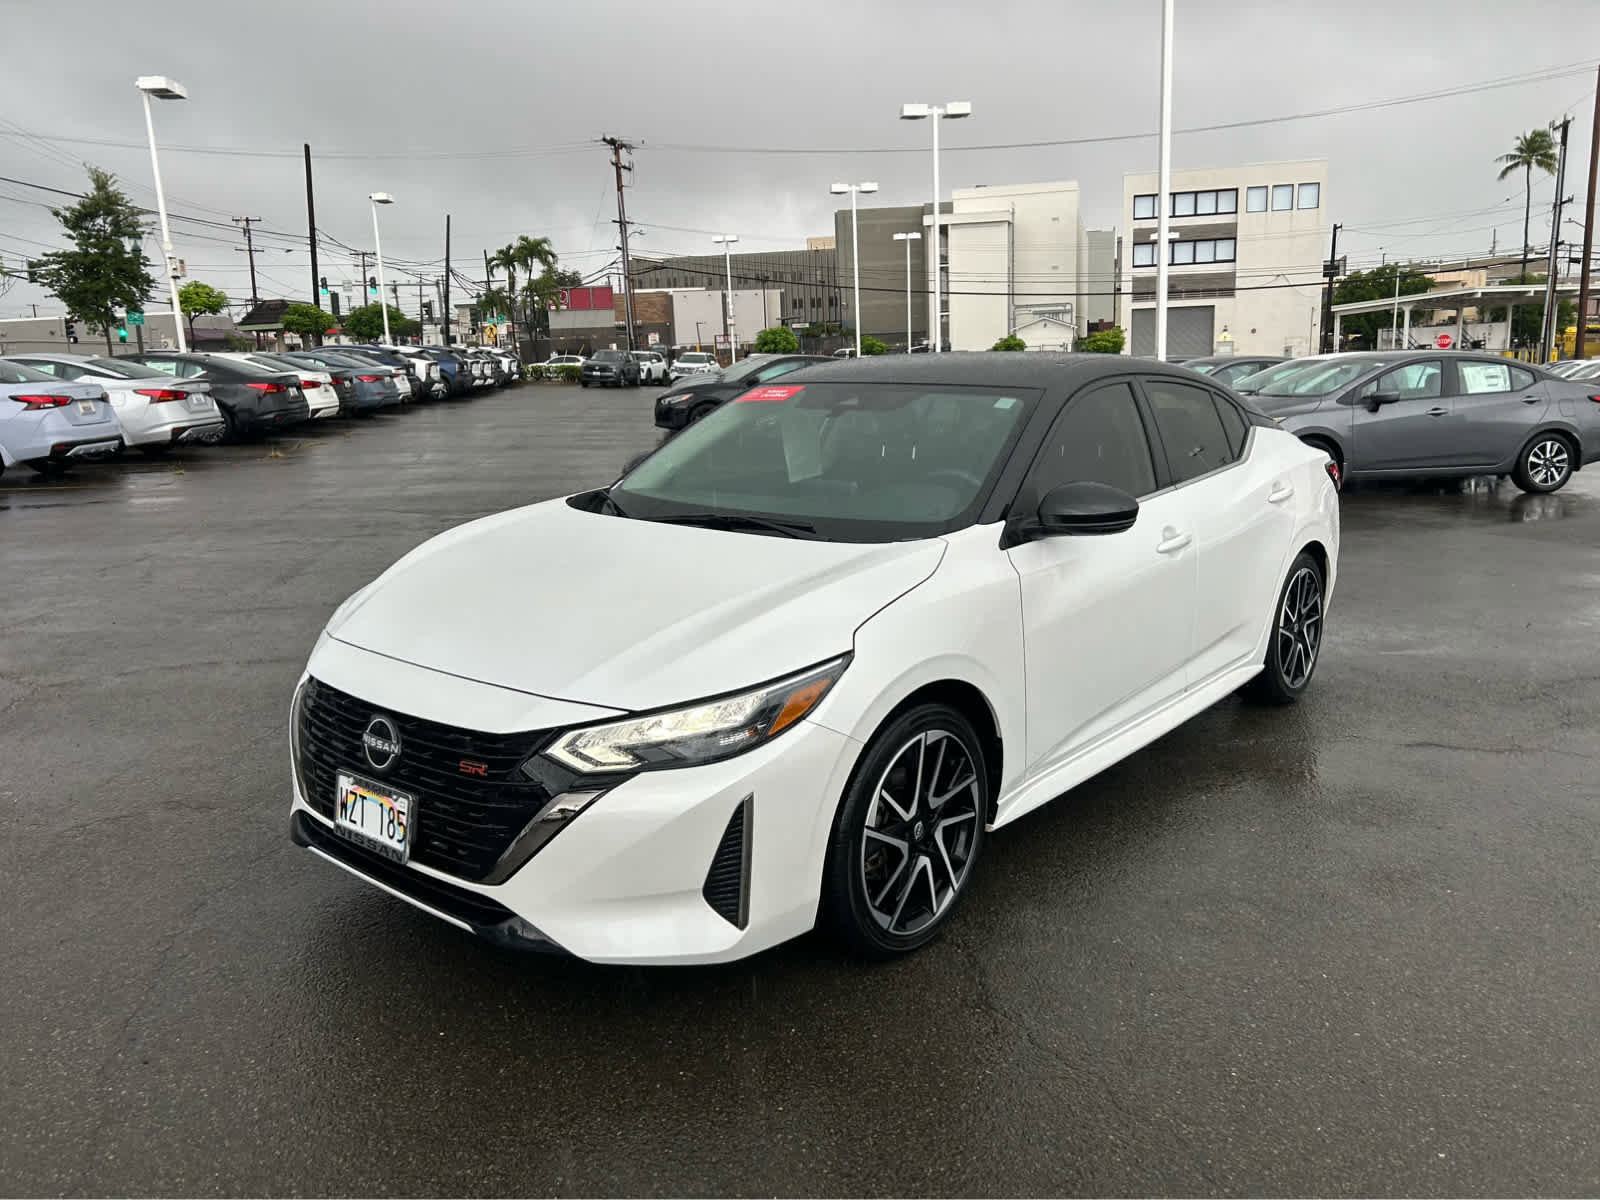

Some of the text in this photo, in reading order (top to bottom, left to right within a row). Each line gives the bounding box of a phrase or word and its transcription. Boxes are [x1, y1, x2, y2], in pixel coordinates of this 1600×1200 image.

[362, 732, 399, 754] NISSAN
[459, 760, 488, 776] SR
[340, 786, 367, 828] WZT
[380, 803, 406, 843] 185
[335, 824, 403, 863] NISSAN
